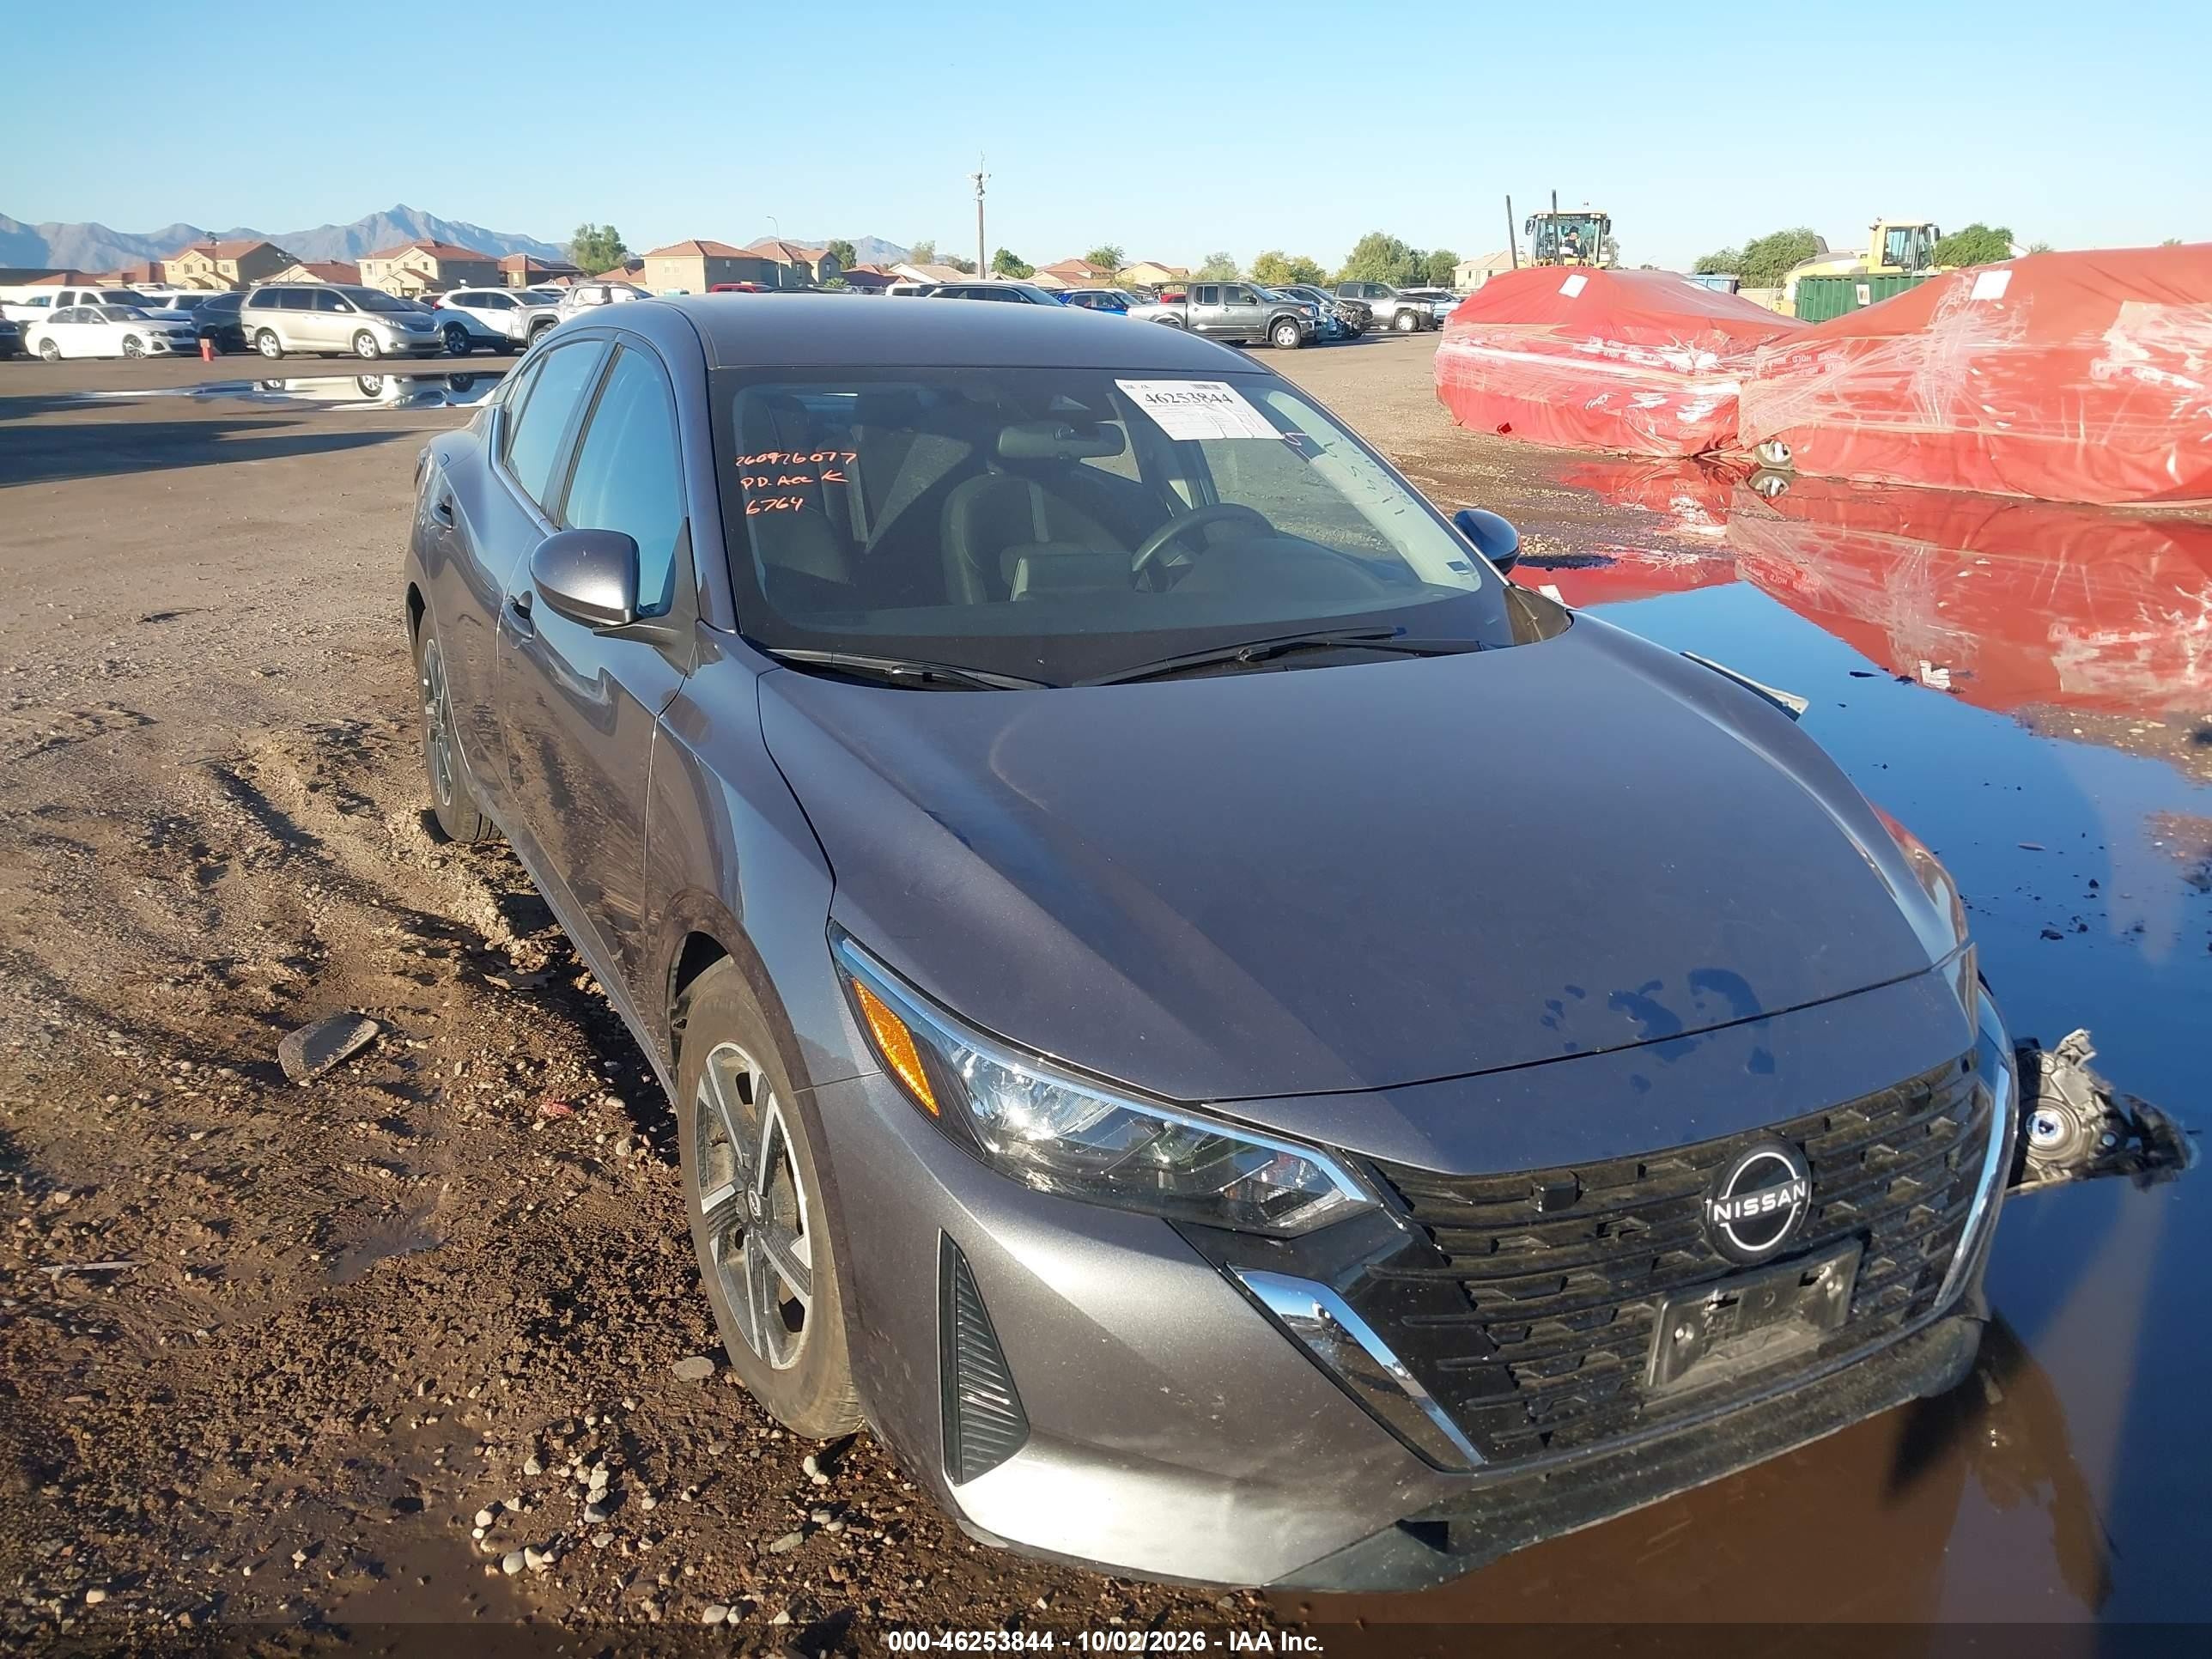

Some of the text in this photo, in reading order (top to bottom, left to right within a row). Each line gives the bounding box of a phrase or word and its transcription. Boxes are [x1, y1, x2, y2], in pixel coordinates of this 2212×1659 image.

[1145, 392, 1234, 404] 46253844
[745, 496, 804, 515] 6764
[1713, 1181, 1806, 1222] NISSAN
